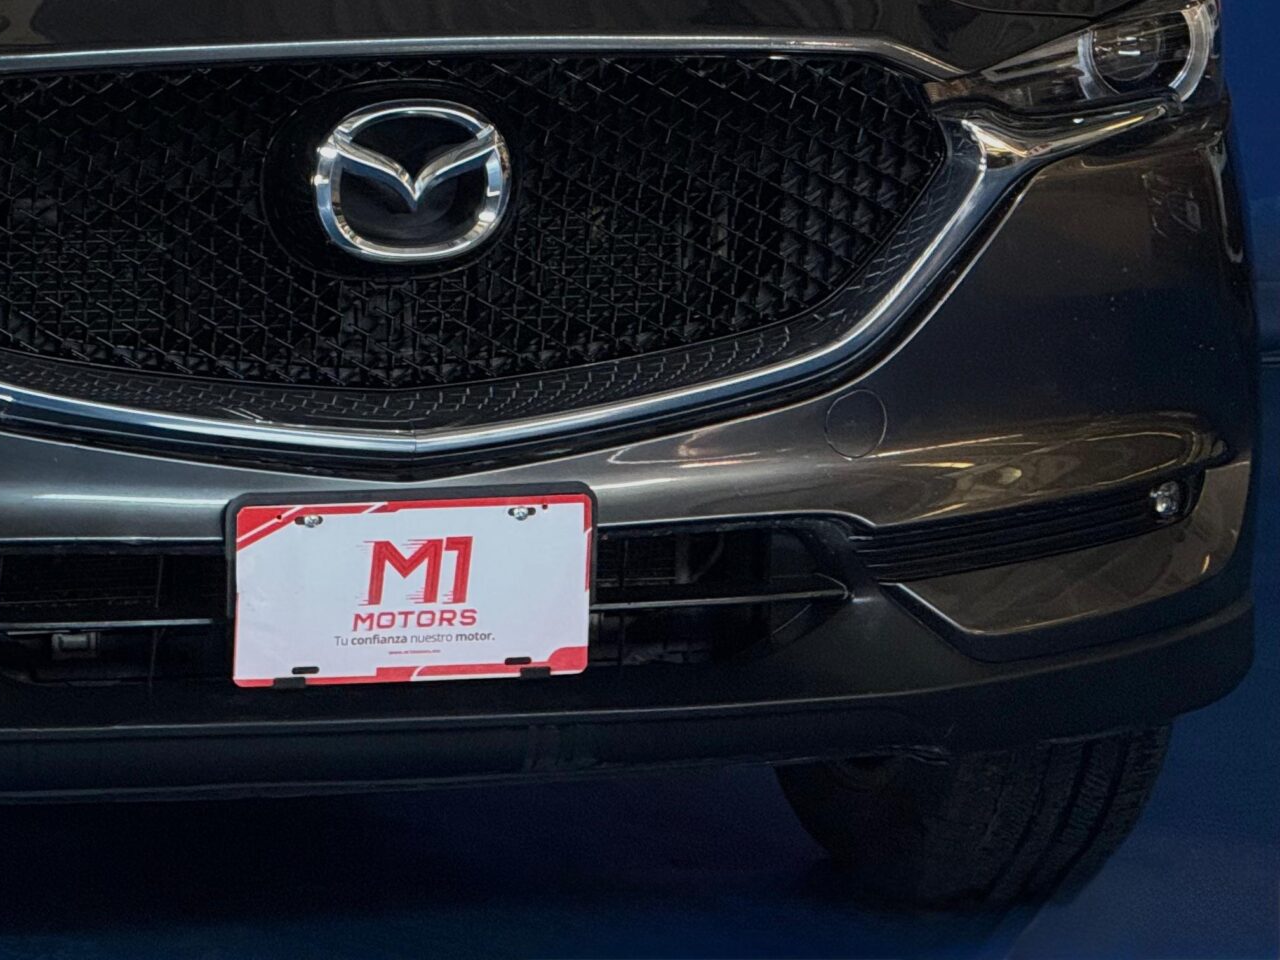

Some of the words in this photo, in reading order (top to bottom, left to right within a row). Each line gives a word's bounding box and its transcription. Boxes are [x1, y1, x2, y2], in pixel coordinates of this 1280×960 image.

[357, 536, 473, 606] M1
[352, 608, 478, 632] MOTORS
[334, 635, 349, 646] Tu
[351, 633, 407, 646] confianza
[410, 632, 453, 643] nuestro
[455, 630, 496, 641] motor.
